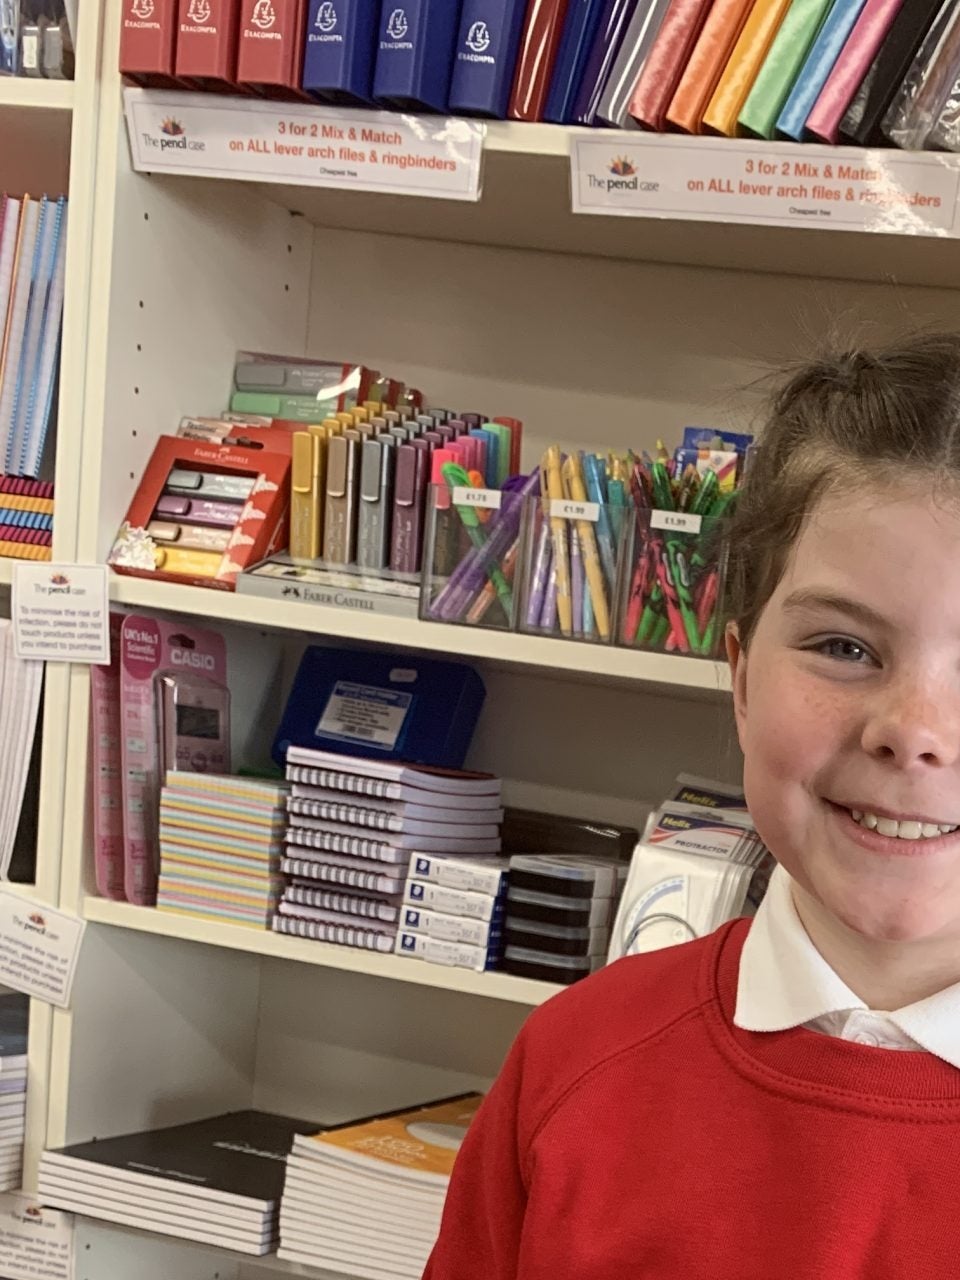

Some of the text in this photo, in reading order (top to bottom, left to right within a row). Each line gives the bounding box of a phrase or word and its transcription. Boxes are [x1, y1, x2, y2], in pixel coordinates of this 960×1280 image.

[125, 20, 160, 29] EXACOMPTA
[181, 25, 216, 33] EXACOMPTA
[244, 30, 281, 39] EXACOMPTA
[142, 133, 205, 152] The pencil case
[278, 122, 402, 145] 3 for 2 Mix & Match
[230, 139, 456, 172] on ALL lever arch files & ringbinders
[170, 650, 215, 670] CASIO
